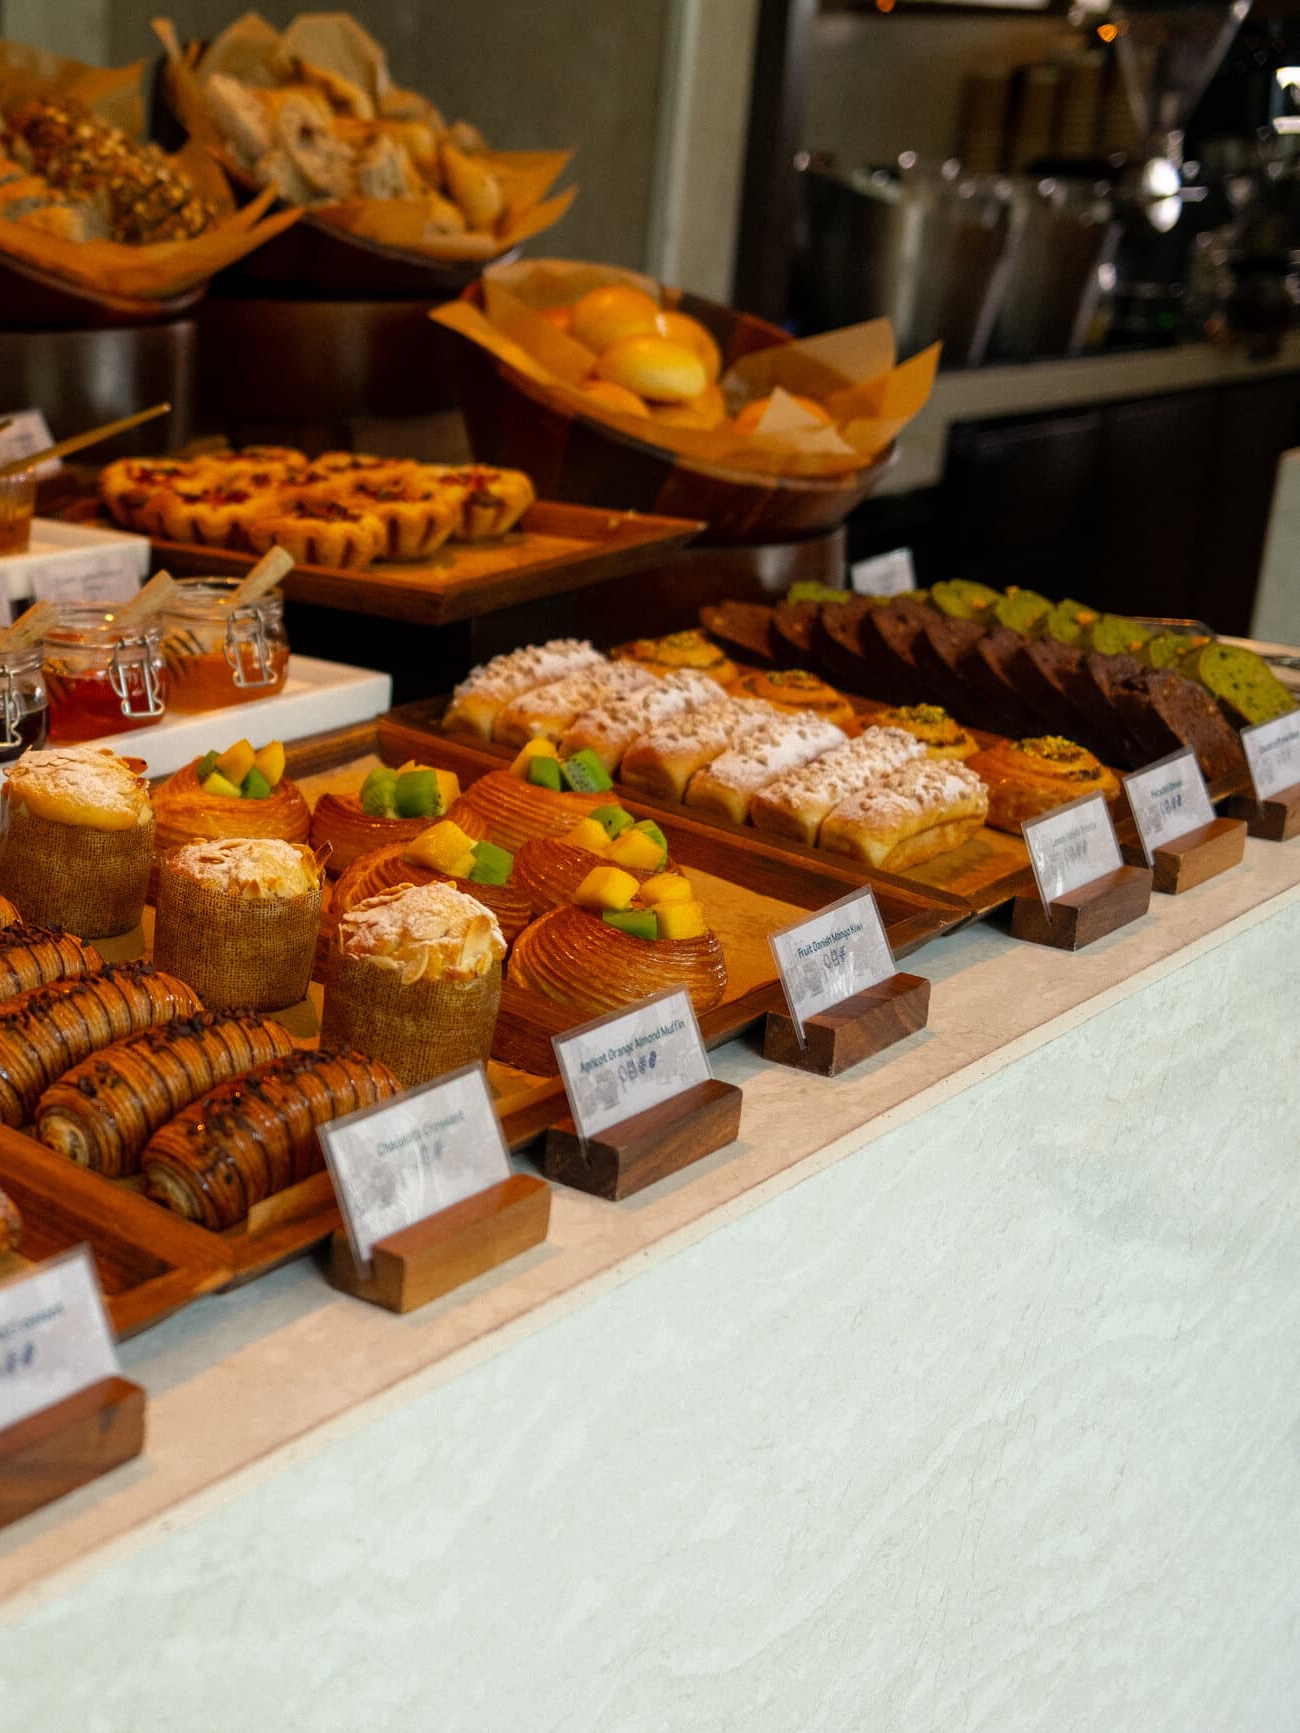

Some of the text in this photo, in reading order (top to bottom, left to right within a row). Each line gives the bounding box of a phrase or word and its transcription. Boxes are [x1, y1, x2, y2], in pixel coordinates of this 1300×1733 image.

[796, 943, 813, 959] Fruit
[830, 928, 850, 943] Mango
[580, 1019, 685, 1073] Apricot Orange Almond Muffin
